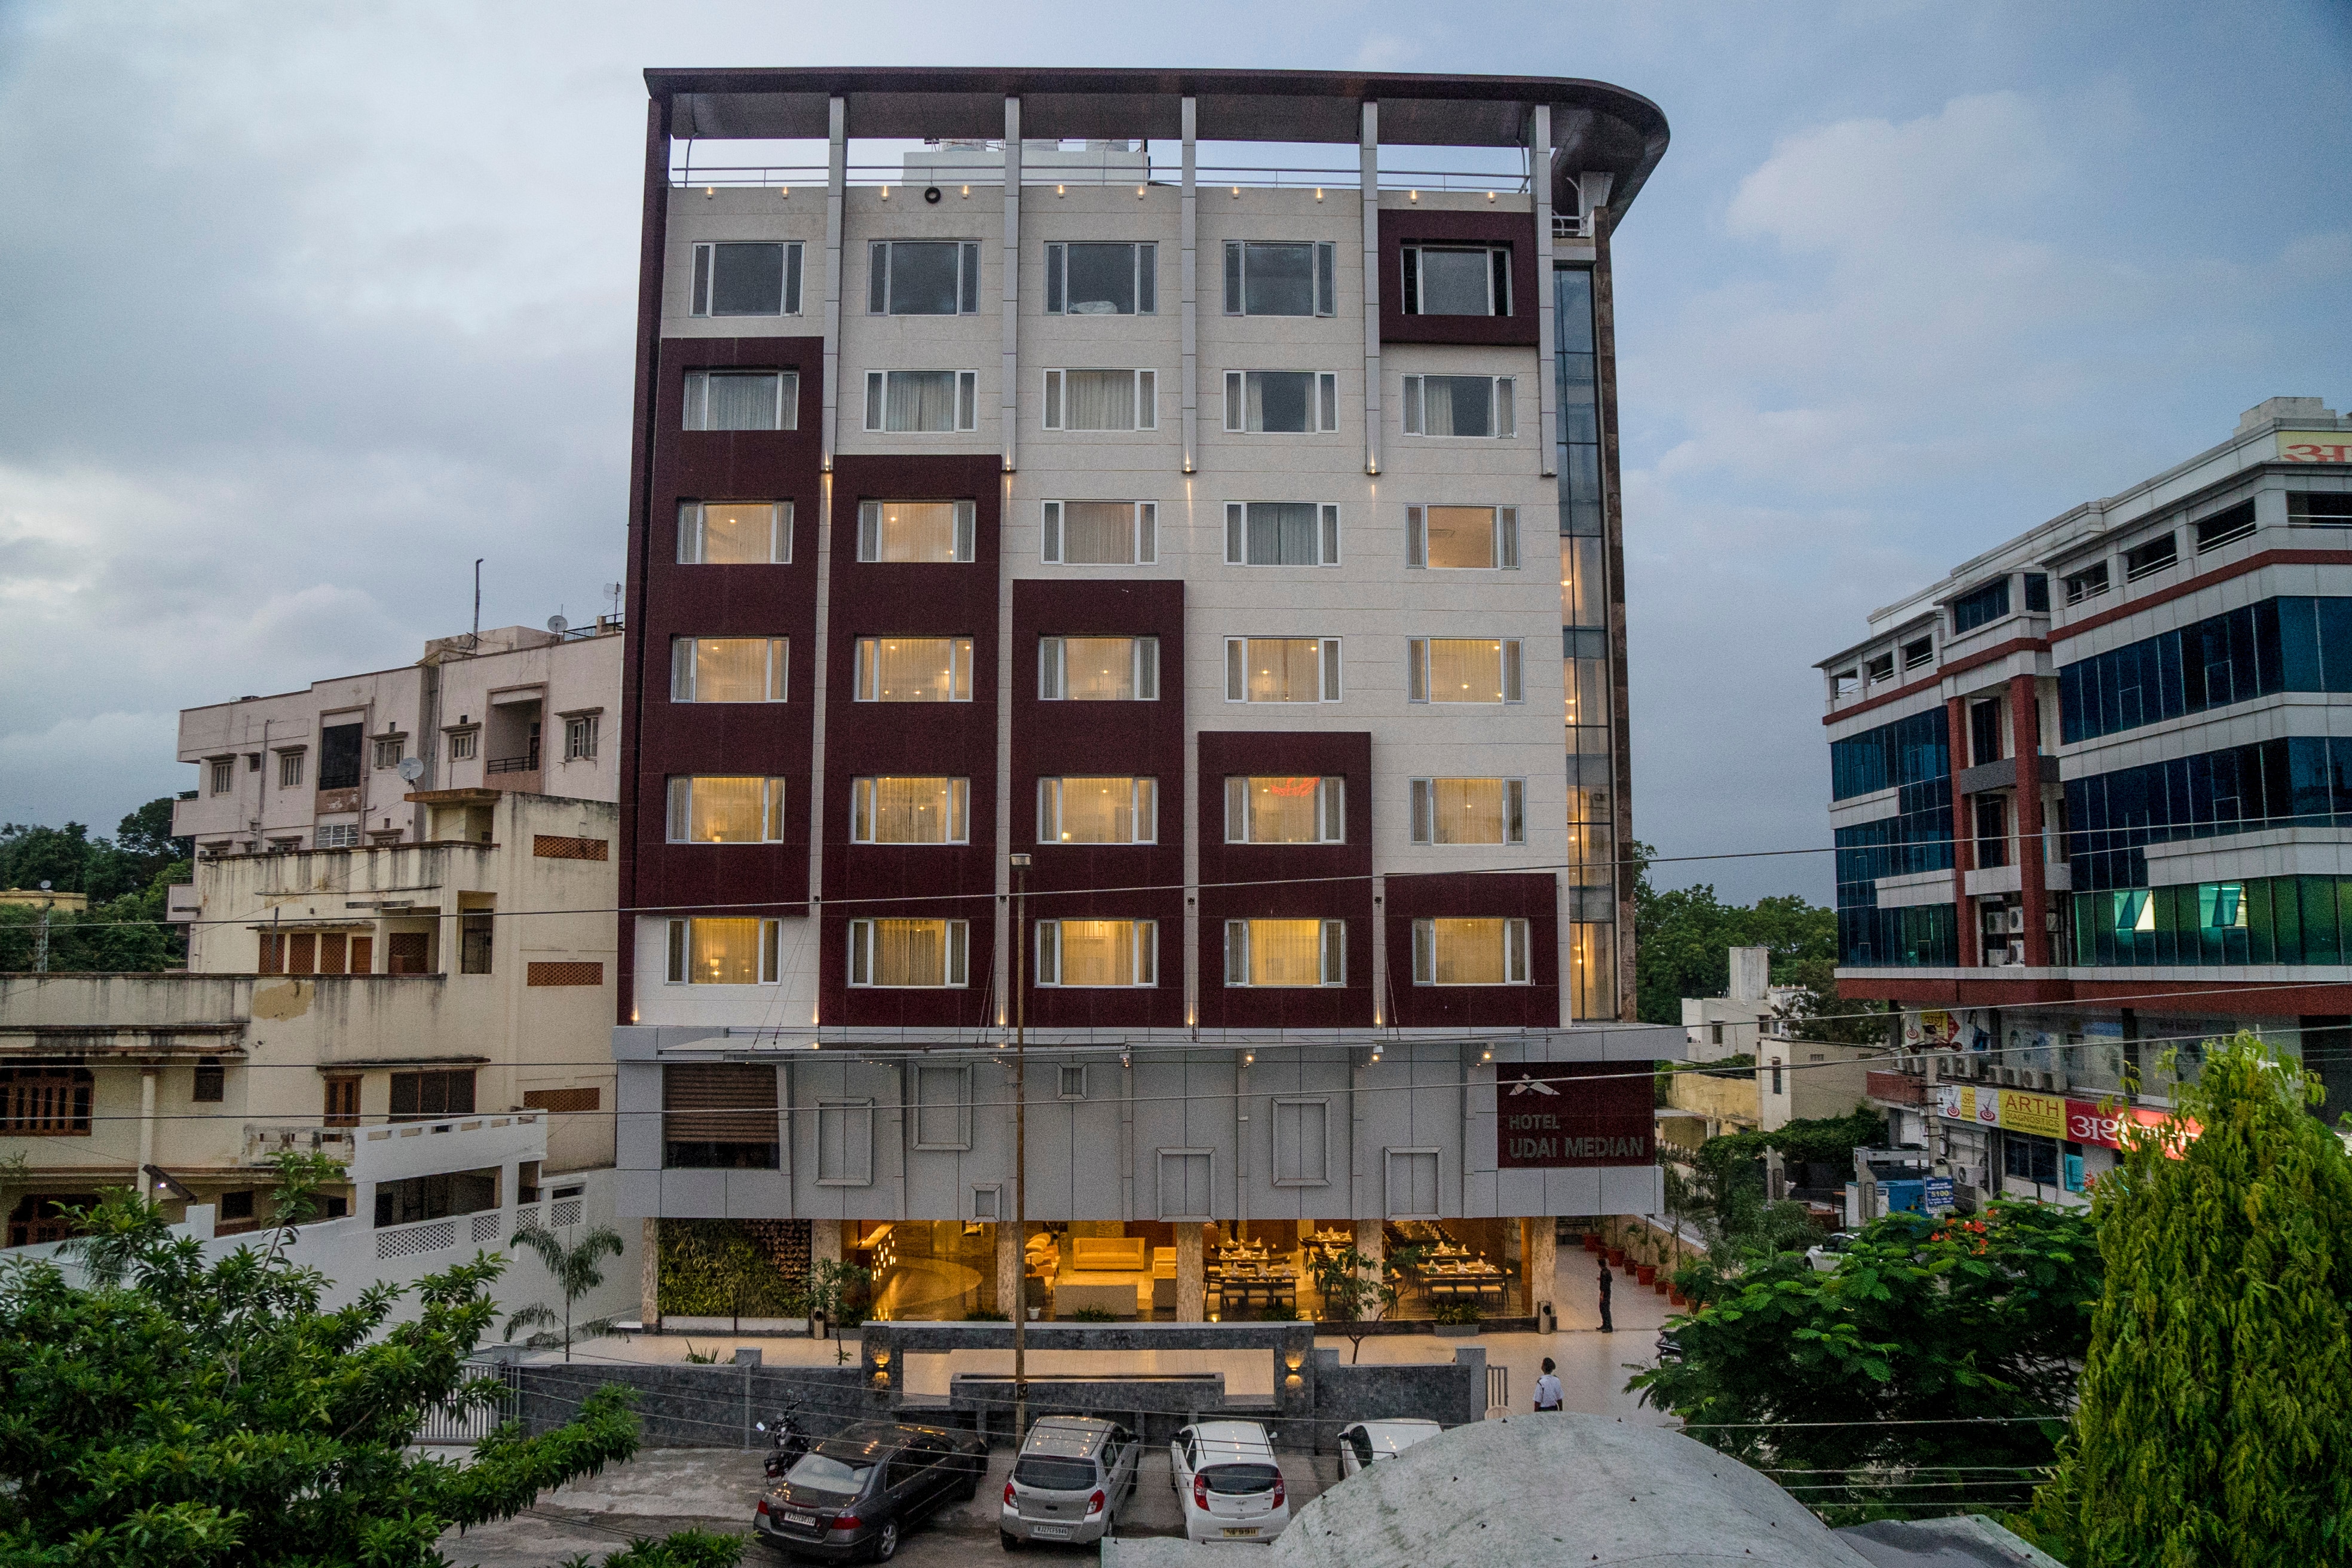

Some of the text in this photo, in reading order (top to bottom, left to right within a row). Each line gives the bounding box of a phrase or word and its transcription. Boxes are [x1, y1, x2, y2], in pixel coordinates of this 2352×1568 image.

[2005, 1094, 2059, 1117] ARTH
[1509, 1114, 1561, 1130] HOTEL
[2005, 1111, 2060, 1128] DIAGNOSTICS
[1509, 1137, 1644, 1158] UDAI MEDIAN
